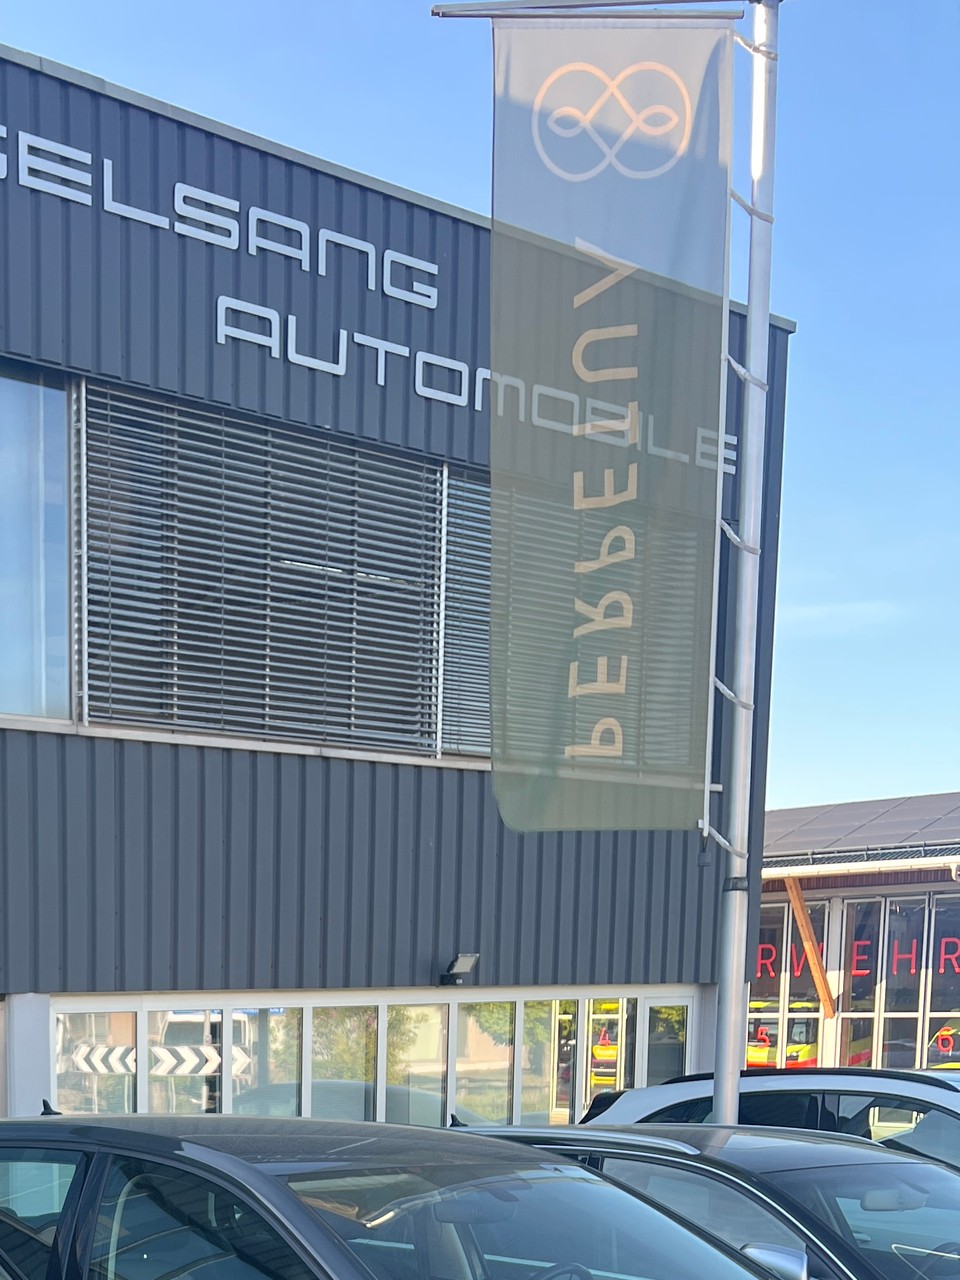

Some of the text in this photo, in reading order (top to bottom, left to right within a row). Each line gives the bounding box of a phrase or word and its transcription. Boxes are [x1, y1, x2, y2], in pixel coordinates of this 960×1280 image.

[598, 1027, 611, 1046] 4
[757, 1027, 771, 1048] 5
[937, 1027, 955, 1053] 6
